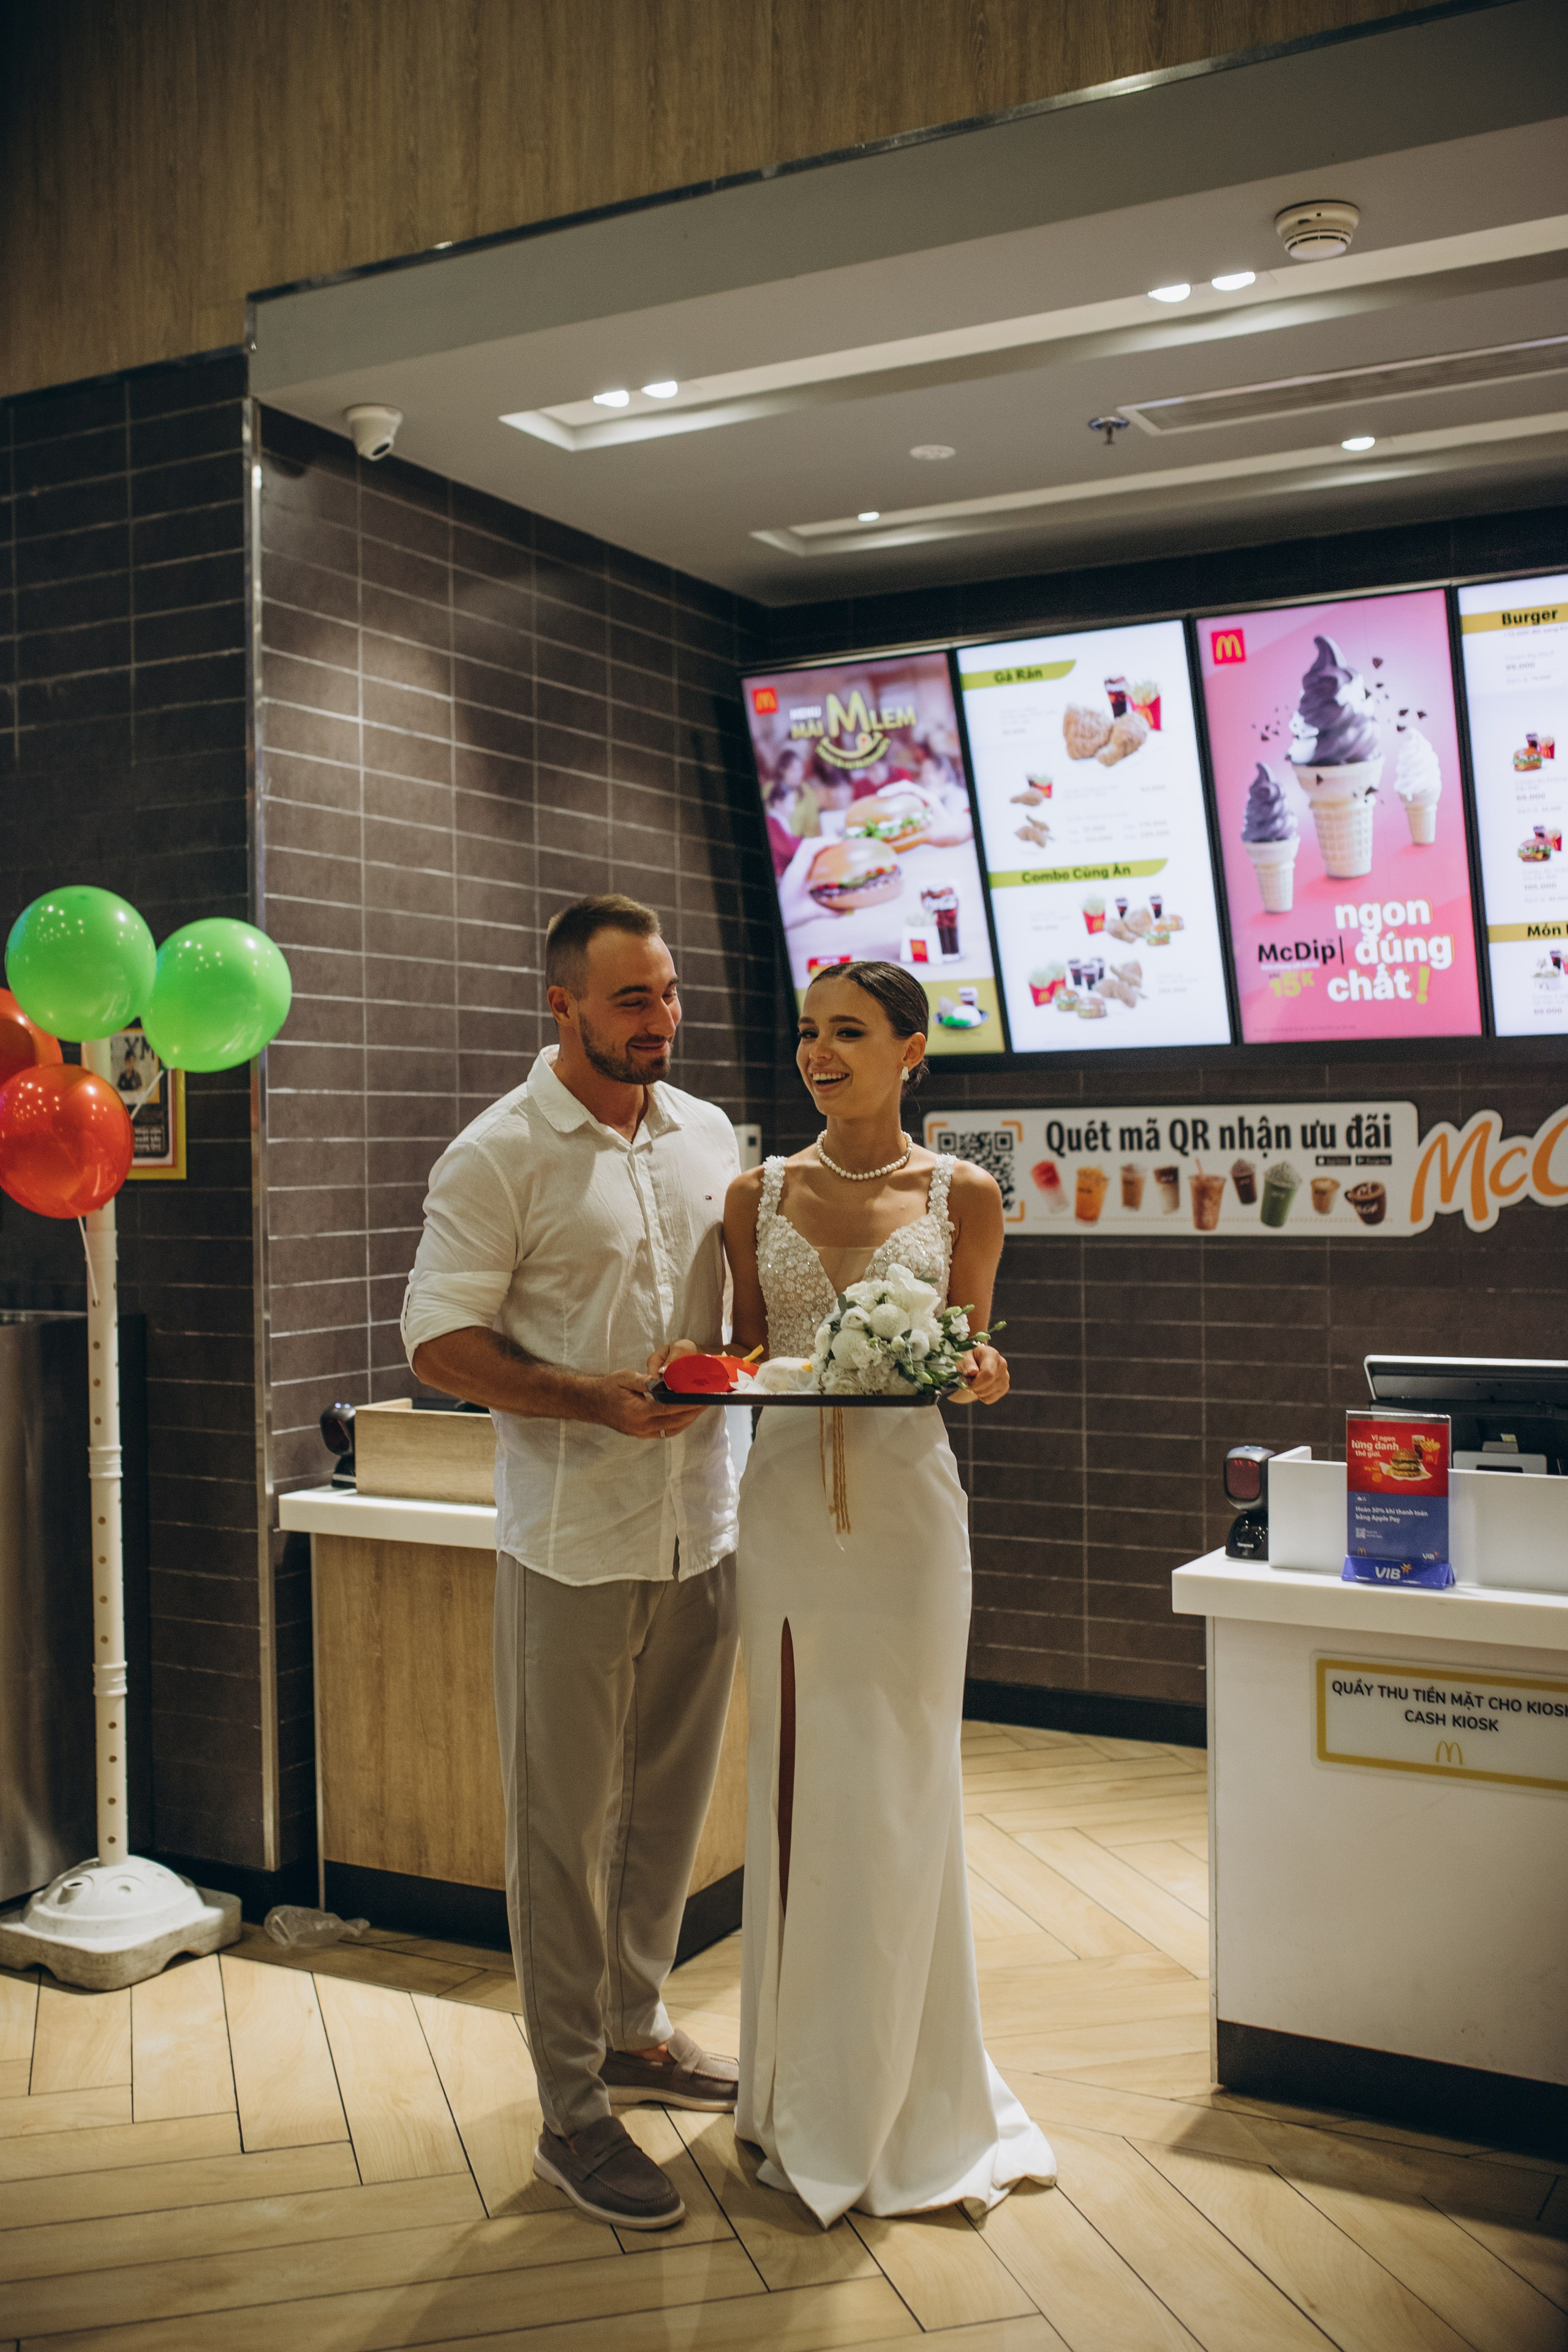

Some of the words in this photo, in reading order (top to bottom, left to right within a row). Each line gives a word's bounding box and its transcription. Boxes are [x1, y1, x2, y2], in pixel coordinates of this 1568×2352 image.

[1502, 609, 1558, 625] Burger
[1022, 870, 1070, 883] Combo
[1073, 866, 1109, 880] Cùng
[1335, 899, 1432, 937] ngon
[1527, 922, 1562, 937] Món
[1258, 939, 1336, 965] McDip
[1355, 932, 1454, 970] đúng
[1046, 1120, 1111, 1158] Quét
[1119, 1118, 1161, 1152] mã
[1169, 1118, 1210, 1156] QR
[1219, 1115, 1292, 1158] nhận
[1300, 1119, 1336, 1149] ưu
[1346, 1114, 1391, 1148] đãi
[1375, 1441, 1399, 1450] danh
[1375, 1567, 1401, 1580] VIB
[1377, 1685, 1408, 1700] THU
[1413, 1686, 1446, 1704] TIỀN
[1451, 1691, 1483, 1711] MẶT
[1488, 1697, 1521, 1712] CHO
[1404, 1709, 1446, 1726] CASH
[1452, 1714, 1499, 1732] KIOSK
